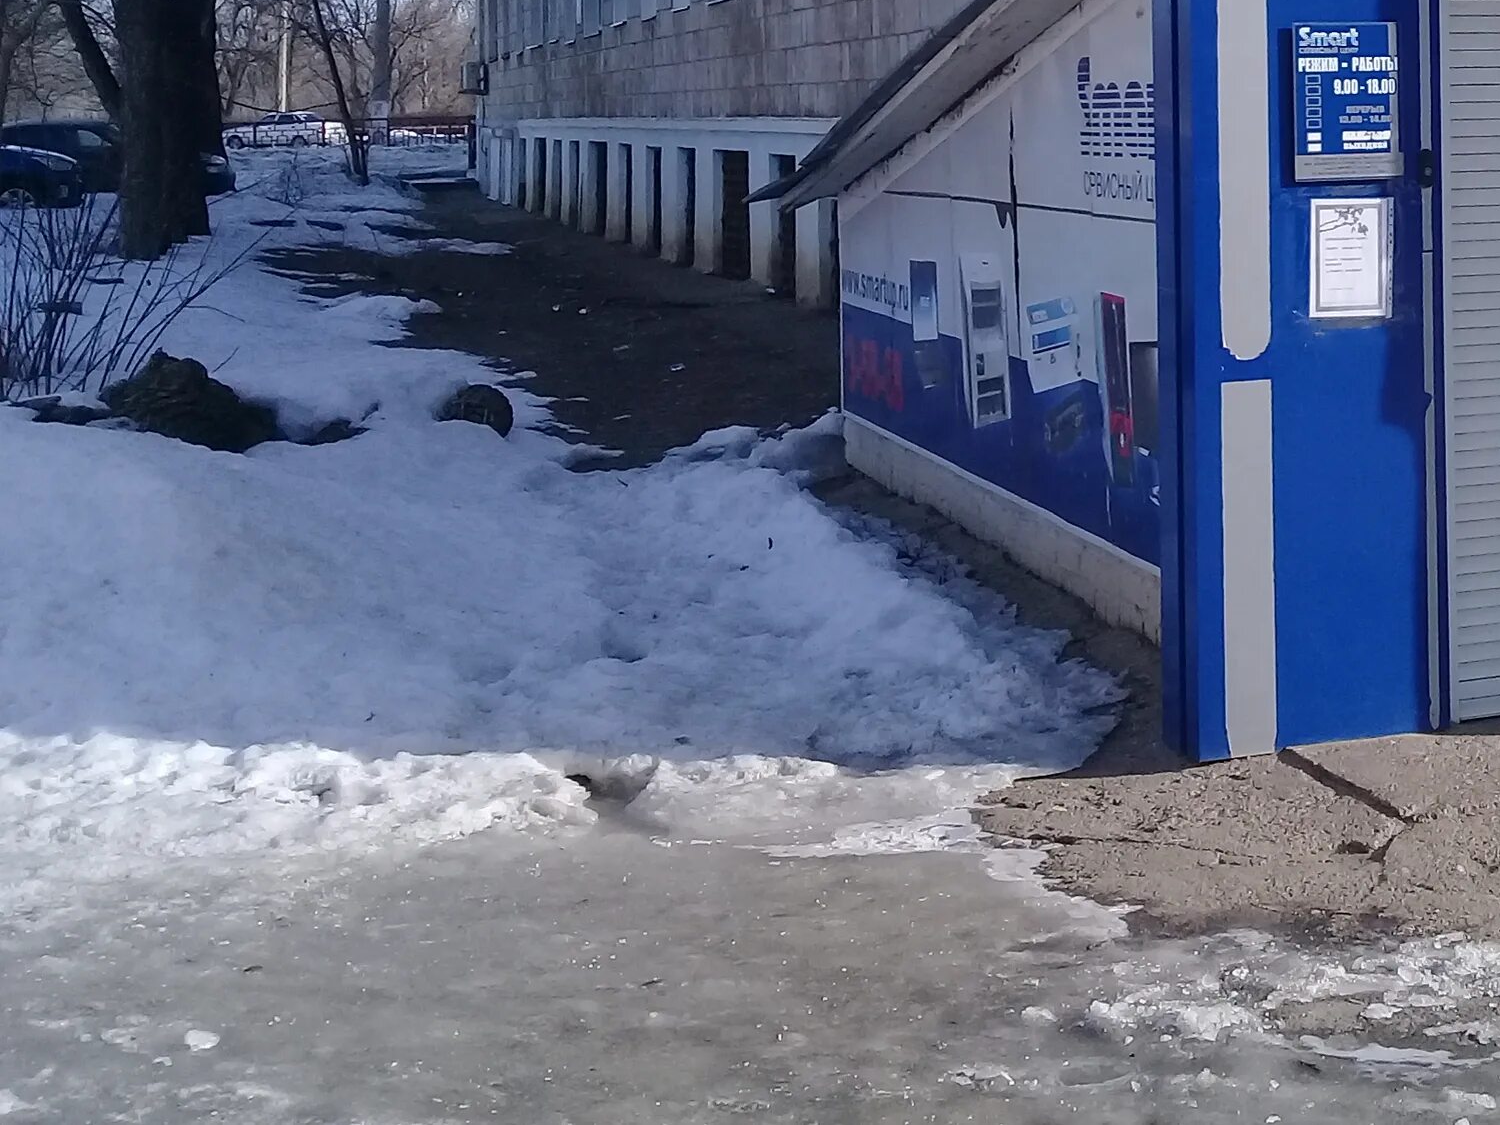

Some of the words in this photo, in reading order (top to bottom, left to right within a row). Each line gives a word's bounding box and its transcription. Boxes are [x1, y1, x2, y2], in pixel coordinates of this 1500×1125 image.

[1298, 26, 1359, 46] Smart
[1298, 57, 1339, 72] РЕЖИМ
[1352, 56, 1398, 72] РАБОТЫ
